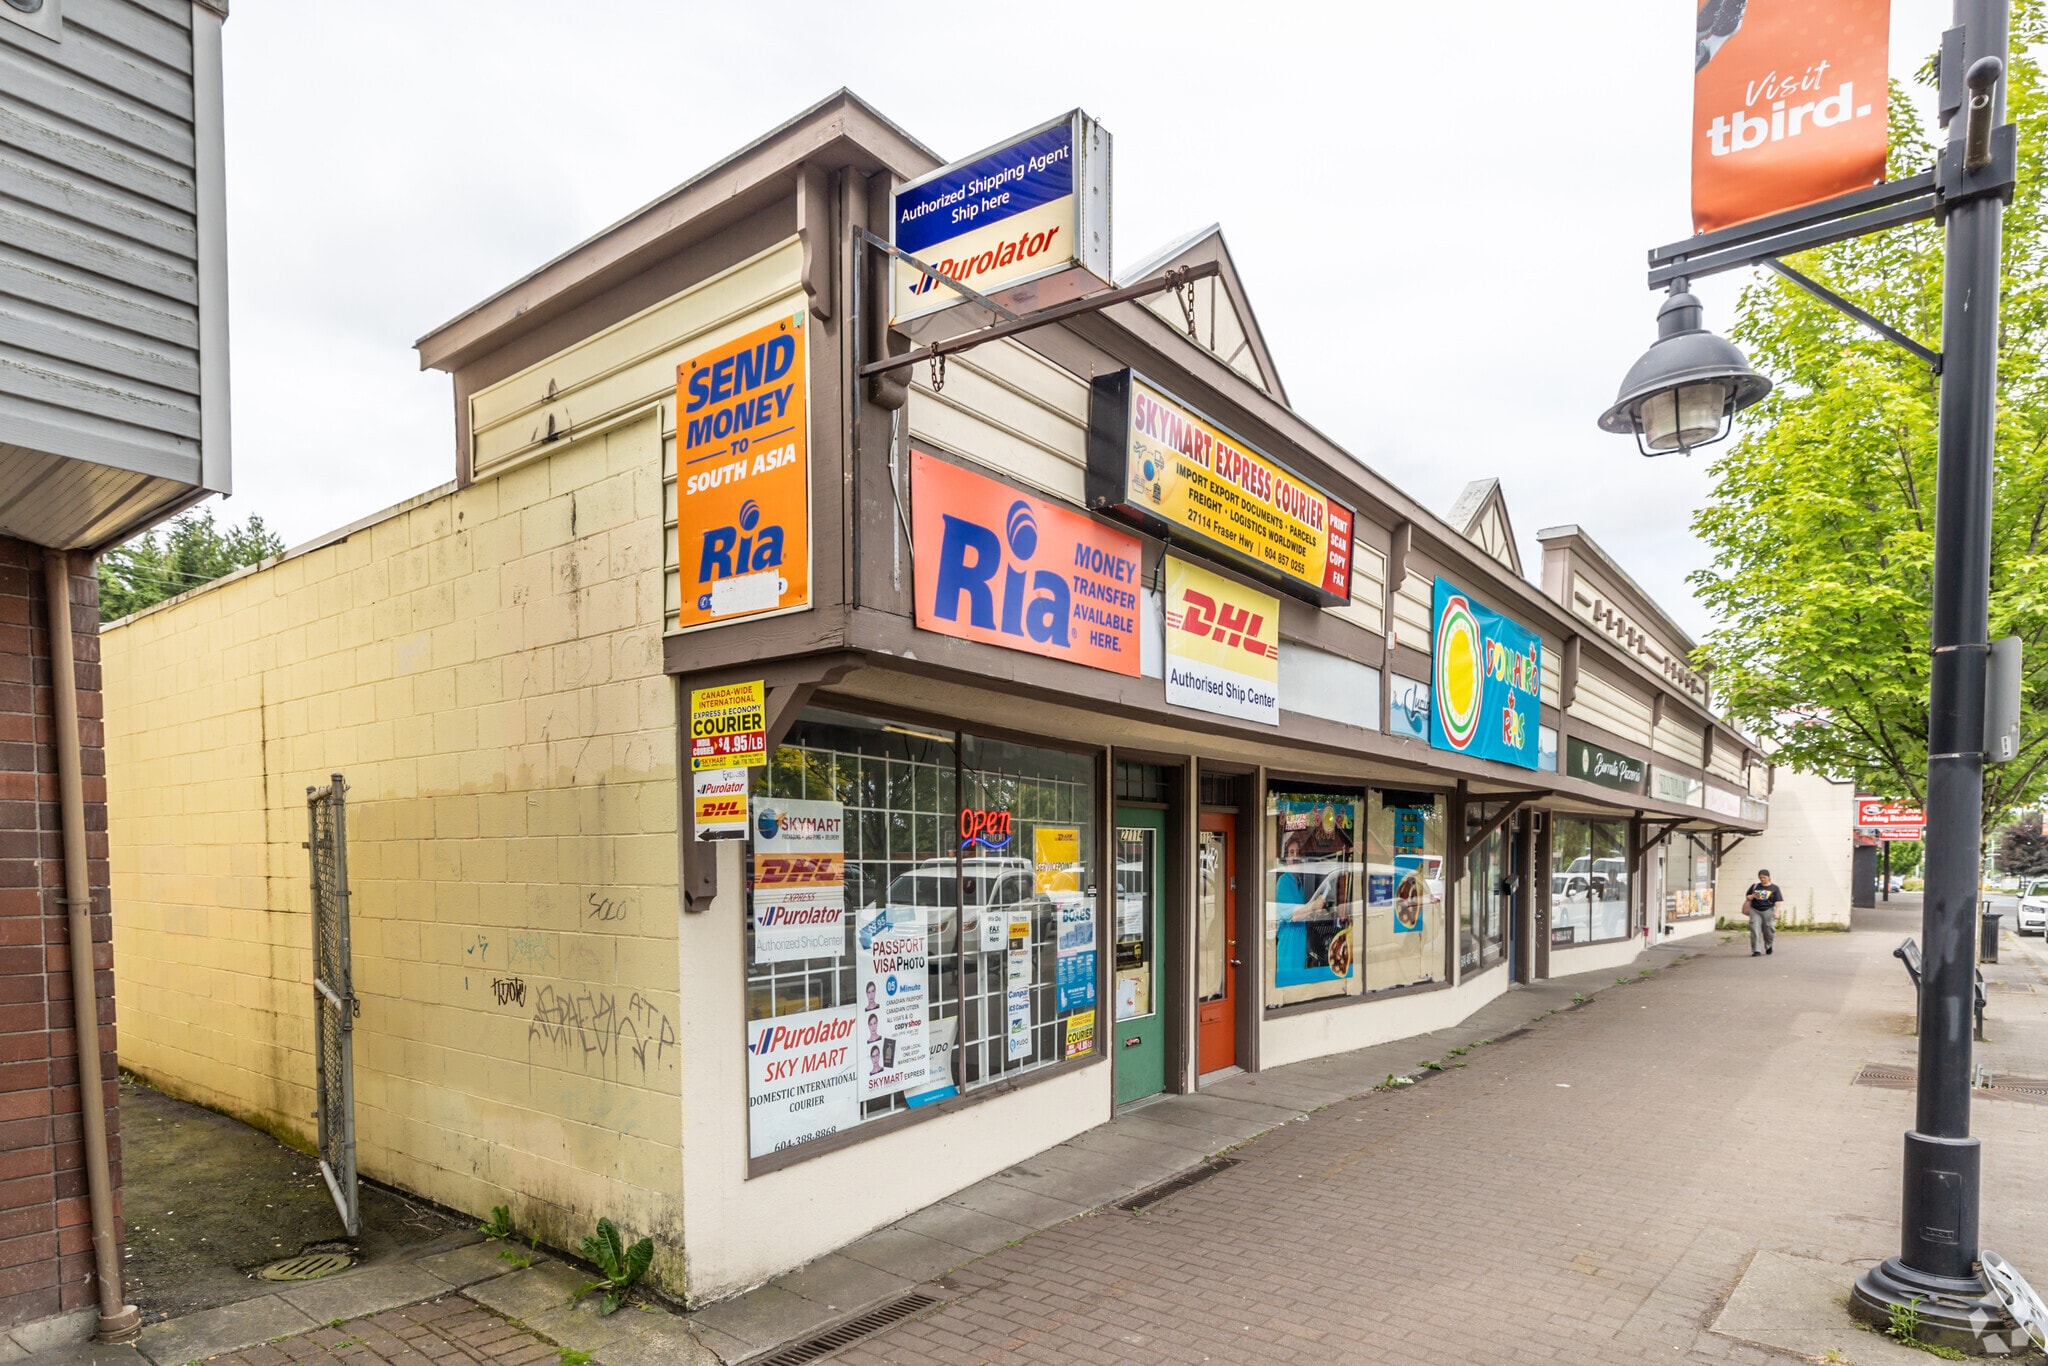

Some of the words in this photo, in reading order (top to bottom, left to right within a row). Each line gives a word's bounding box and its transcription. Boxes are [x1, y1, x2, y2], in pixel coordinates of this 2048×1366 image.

[1745, 60, 1830, 106] Visit
[1706, 82, 1872, 156] tbird.
[901, 184, 966, 223] Authorized
[968, 164, 1025, 198] Shipping
[1028, 144, 1069, 174] Agent
[952, 203, 978, 224] Ship
[982, 192, 1010, 213] here
[933, 226, 1060, 290] Purolator
[686, 333, 795, 414] SEND
[686, 383, 794, 449] MONEY
[730, 437, 749, 456] TO
[686, 458, 746, 495] SOUTH
[752, 443, 796, 477] ASIA
[1134, 392, 1212, 470] SKYMART
[1216, 440, 1272, 503] EXPRESS
[1275, 477, 1324, 532] COURIER
[1176, 462, 1208, 489] IMPORT
[1210, 480, 1240, 507] EXPORT
[1241, 497, 1284, 530] DOCUMENTS
[1290, 525, 1316, 547] PARCELS
[1188, 489, 1223, 515] FREIGHT
[1230, 511, 1266, 537] LOGISTICS
[1268, 529, 1306, 557] WORLDWIDE
[1329, 514, 1348, 534] PRINT
[698, 499, 786, 584] Ria
[1188, 508, 1212, 530] 27114
[1214, 522, 1237, 542] Fraser
[1239, 534, 1254, 553] Hwy
[1264, 546, 1276, 561] 604
[1277, 553, 1289, 566] 857
[1290, 559, 1305, 574] 0255
[1330, 534, 1346, 552] SCAN
[1074, 542, 1136, 584] MONEY
[1330, 551, 1346, 569] COPY
[934, 500, 1071, 648] Ria
[1333, 571, 1344, 588] FAX
[1073, 576, 1136, 610] TRANSFER
[1073, 603, 1133, 634] AVAILABLE
[1182, 588, 1268, 656] DHL
[1090, 630, 1122, 653] HERE.
[701, 685, 753, 700] CANADA-WIDE
[1170, 668, 1224, 696] Authorised
[1226, 682, 1246, 704] Ship
[1248, 688, 1275, 709] Center
[694, 708, 721, 720] EXPRESS
[729, 704, 762, 715] ECONOMY
[698, 694, 756, 709] INTERNATIONAL
[694, 712, 762, 736] COURIER
[718, 734, 764, 753] $4.95/LB
[706, 782, 744, 794] Purolator
[702, 802, 740, 816] DHL
[1862, 815, 1888, 823] Parking
[782, 816, 841, 832] SKYMART
[1121, 829, 1144, 840] 27114
[761, 858, 836, 884] DHL
[773, 906, 843, 926] Purolator
[1062, 908, 1090, 922] BOXES
[756, 936, 800, 952] Authorized
[872, 937, 924, 956] PASSPORT
[887, 981, 896, 992] 05
[900, 984, 922, 993] Minute
[770, 1018, 856, 1052] Purolator
[1068, 1028, 1092, 1043] COURIER
[929, 1042, 948, 1055] UDO
[764, 1057, 798, 1083] SKY
[801, 1046, 848, 1074] MART
[750, 1087, 795, 1108] DOMESTIC
[796, 1072, 858, 1096] INTERNATIONAL
[868, 1072, 904, 1090] SKYMART
[789, 1095, 824, 1112] COURIER
